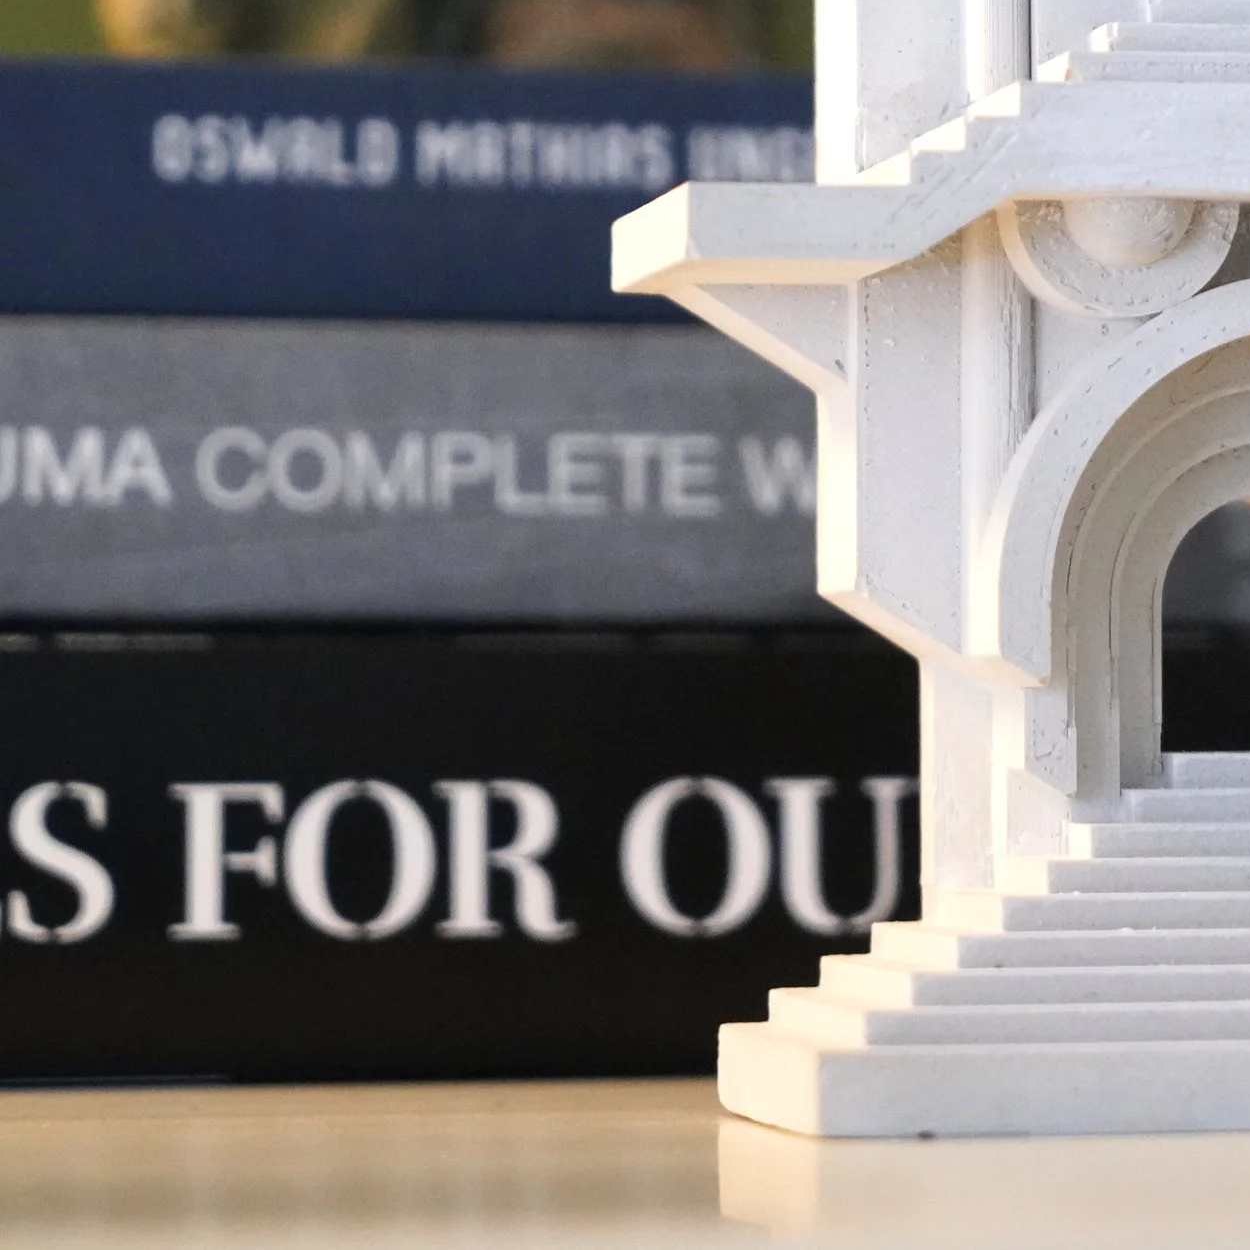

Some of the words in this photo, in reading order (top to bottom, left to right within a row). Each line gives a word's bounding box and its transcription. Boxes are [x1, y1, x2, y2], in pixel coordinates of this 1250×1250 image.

[152, 113, 400, 186] OSWALD
[414, 120, 674, 190] MATHIAS
[193, 424, 721, 517] COMPLETE
[167, 779, 576, 942] FOR
